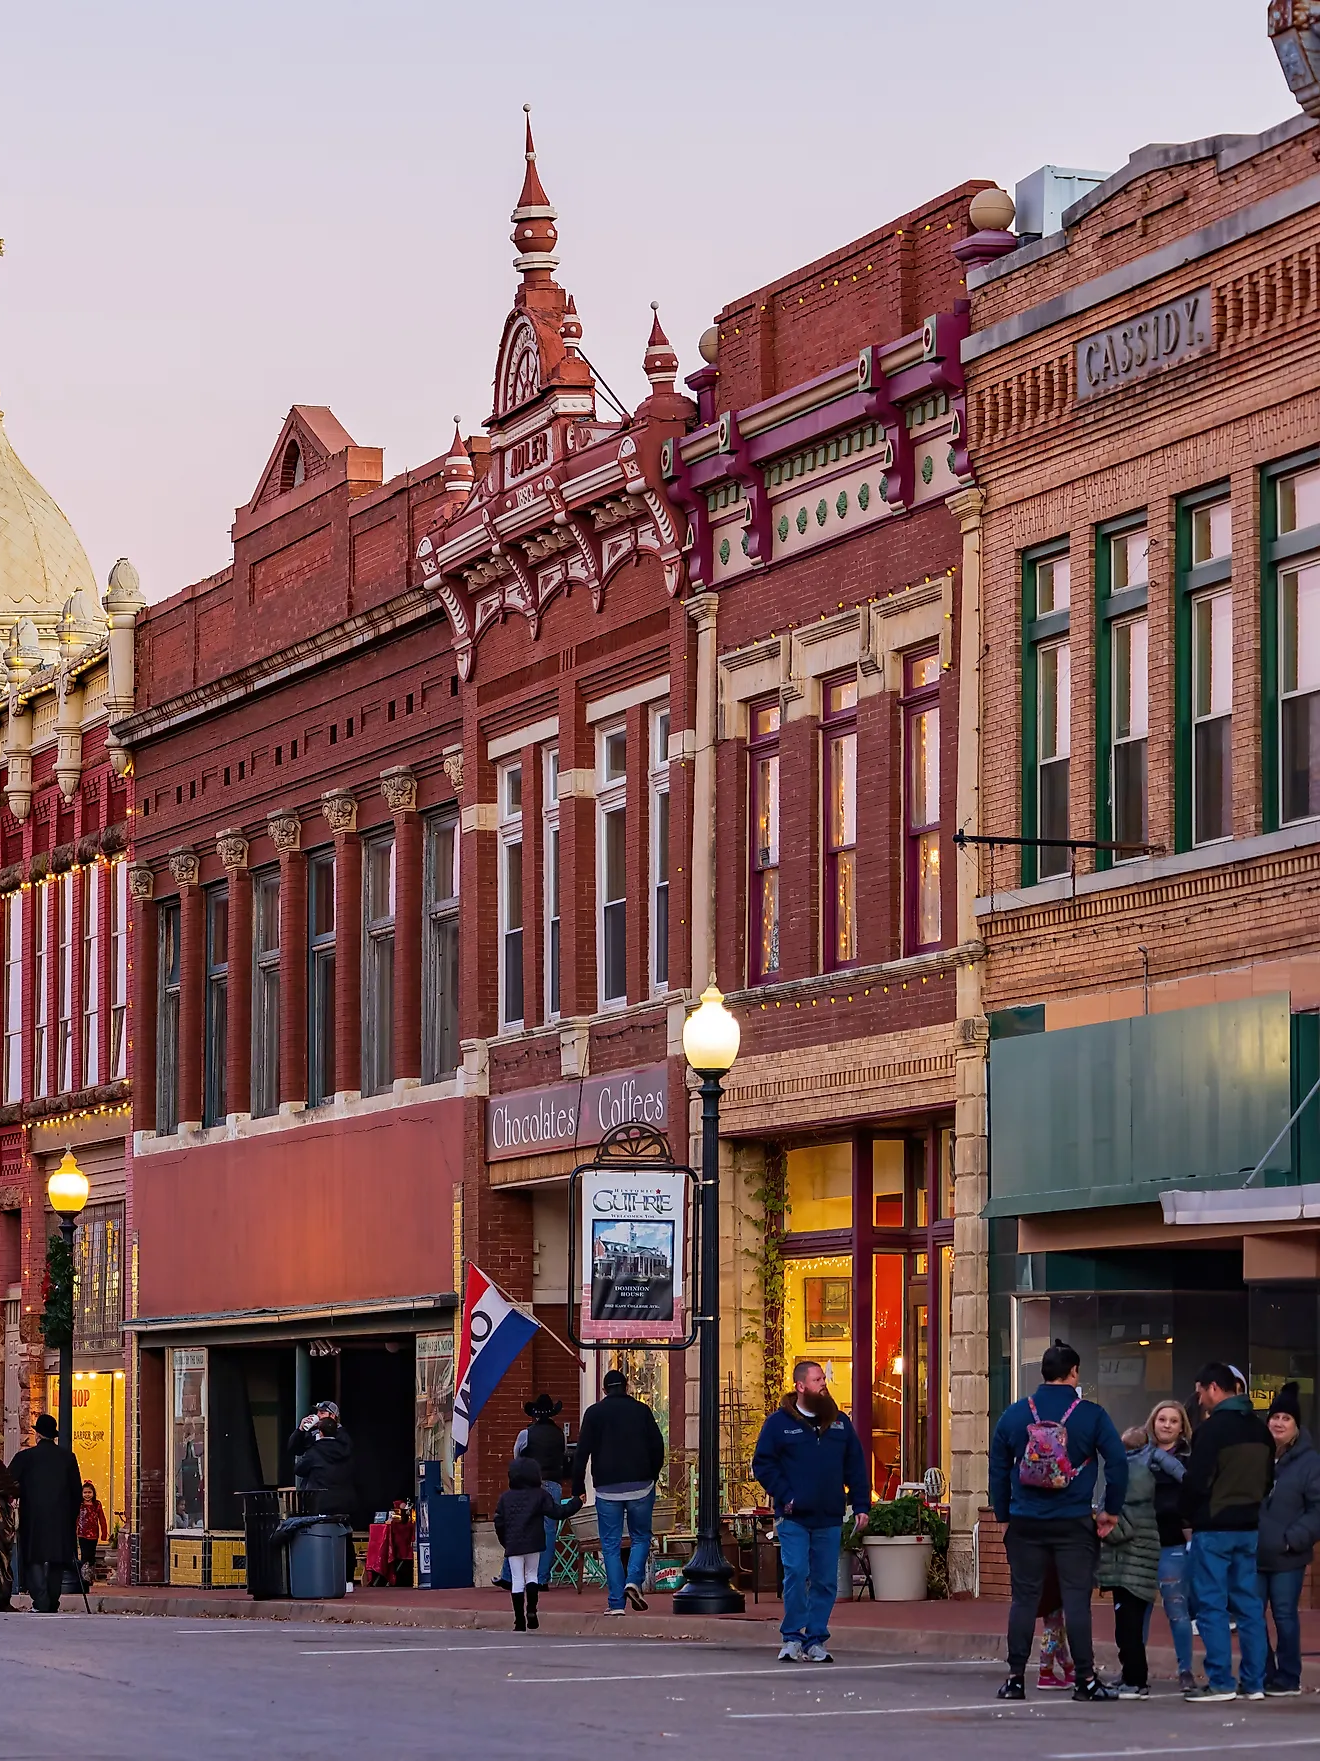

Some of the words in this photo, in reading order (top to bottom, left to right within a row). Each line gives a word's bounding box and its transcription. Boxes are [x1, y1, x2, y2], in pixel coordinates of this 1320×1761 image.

[510, 432, 548, 478] ADLER
[492, 1096, 575, 1149] Chocolates
[598, 1079, 664, 1131] Coffees
[592, 1189, 673, 1214] GUTHRIE
